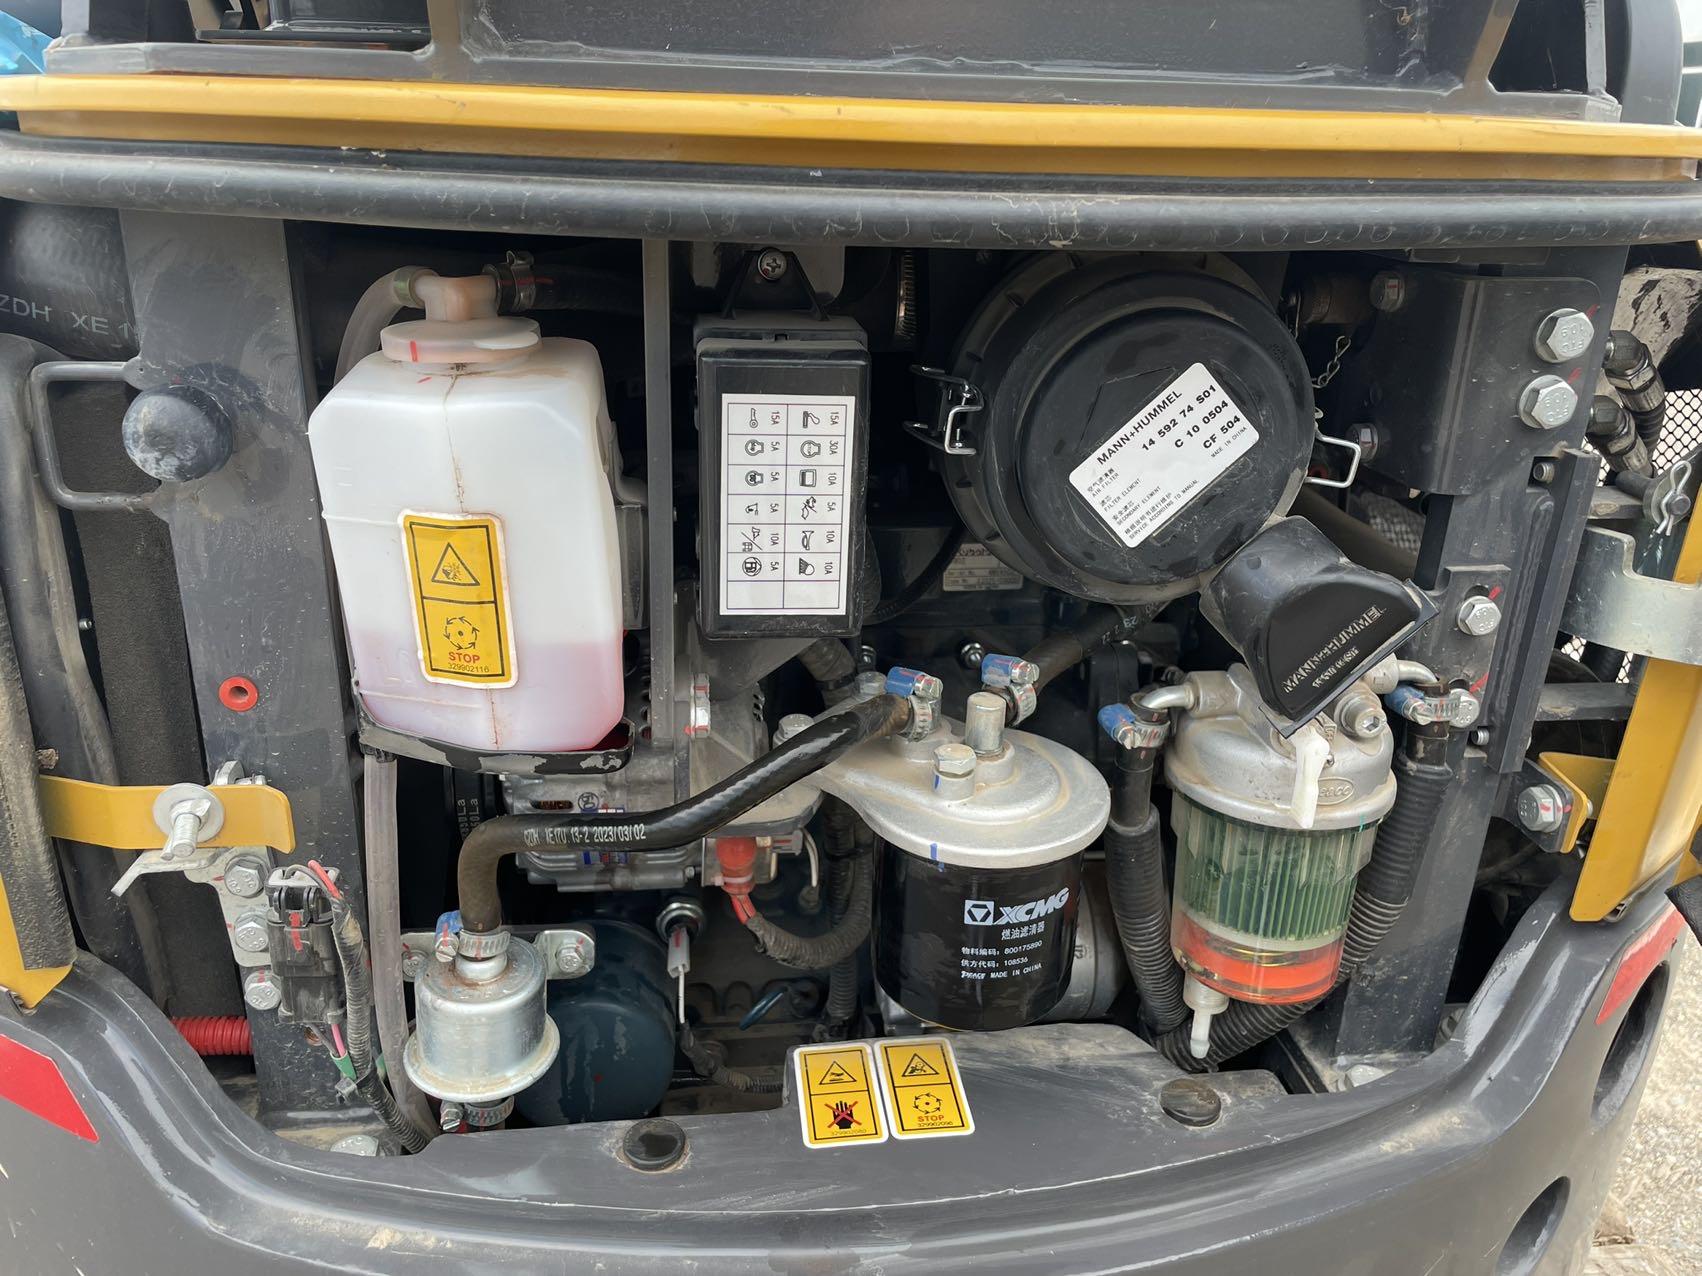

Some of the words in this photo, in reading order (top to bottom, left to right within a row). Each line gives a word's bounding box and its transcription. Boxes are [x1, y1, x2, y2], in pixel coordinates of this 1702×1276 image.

[771, 411, 780, 425] 15A
[829, 411, 839, 426] 15A
[1142, 438, 1155, 451] 14
[1157, 418, 1177, 437] 592
[1180, 404, 1193, 418] 74
[1196, 385, 1215, 403] S01
[1174, 438, 1183, 448] C
[1186, 424, 1199, 437] 10
[1202, 400, 1227, 424] 0504
[1096, 387, 1182, 465] MANN+HUMMEL
[1203, 434, 1217, 448] CF
[1220, 415, 1239, 433] 504
[1231, 425, 1246, 440] CHINA
[771, 442, 780, 452] 5A
[829, 440, 838, 455] 30A
[770, 472, 779, 482] 5A
[828, 472, 837, 486] 10A
[1101, 471, 1119, 489] FILTER
[1103, 494, 1121, 512] FILTER
[1121, 478, 1141, 496] ELEMENT
[770, 504, 779, 513] 5A
[827, 502, 836, 512] 5A
[1116, 502, 1141, 526] SECONDARY
[1141, 485, 1161, 504] ELEMENT
[1128, 520, 1148, 539] SERVICE
[1148, 498, 1174, 522] ACCORDING
[1181, 478, 1198, 494] MANUAL
[770, 533, 779, 546] 10A
[826, 530, 835, 544] 10A
[770, 561, 779, 571] 5A
[824, 562, 833, 575] 10A
[448, 651, 480, 663] STOP
[993, 887, 1070, 925] XCMG
[1001, 921, 1045, 940] 燃油滤清器
[1004, 957, 1028, 966] 108536
[1023, 963, 1042, 973] CHINA
[918, 1114, 945, 1122] STOP
